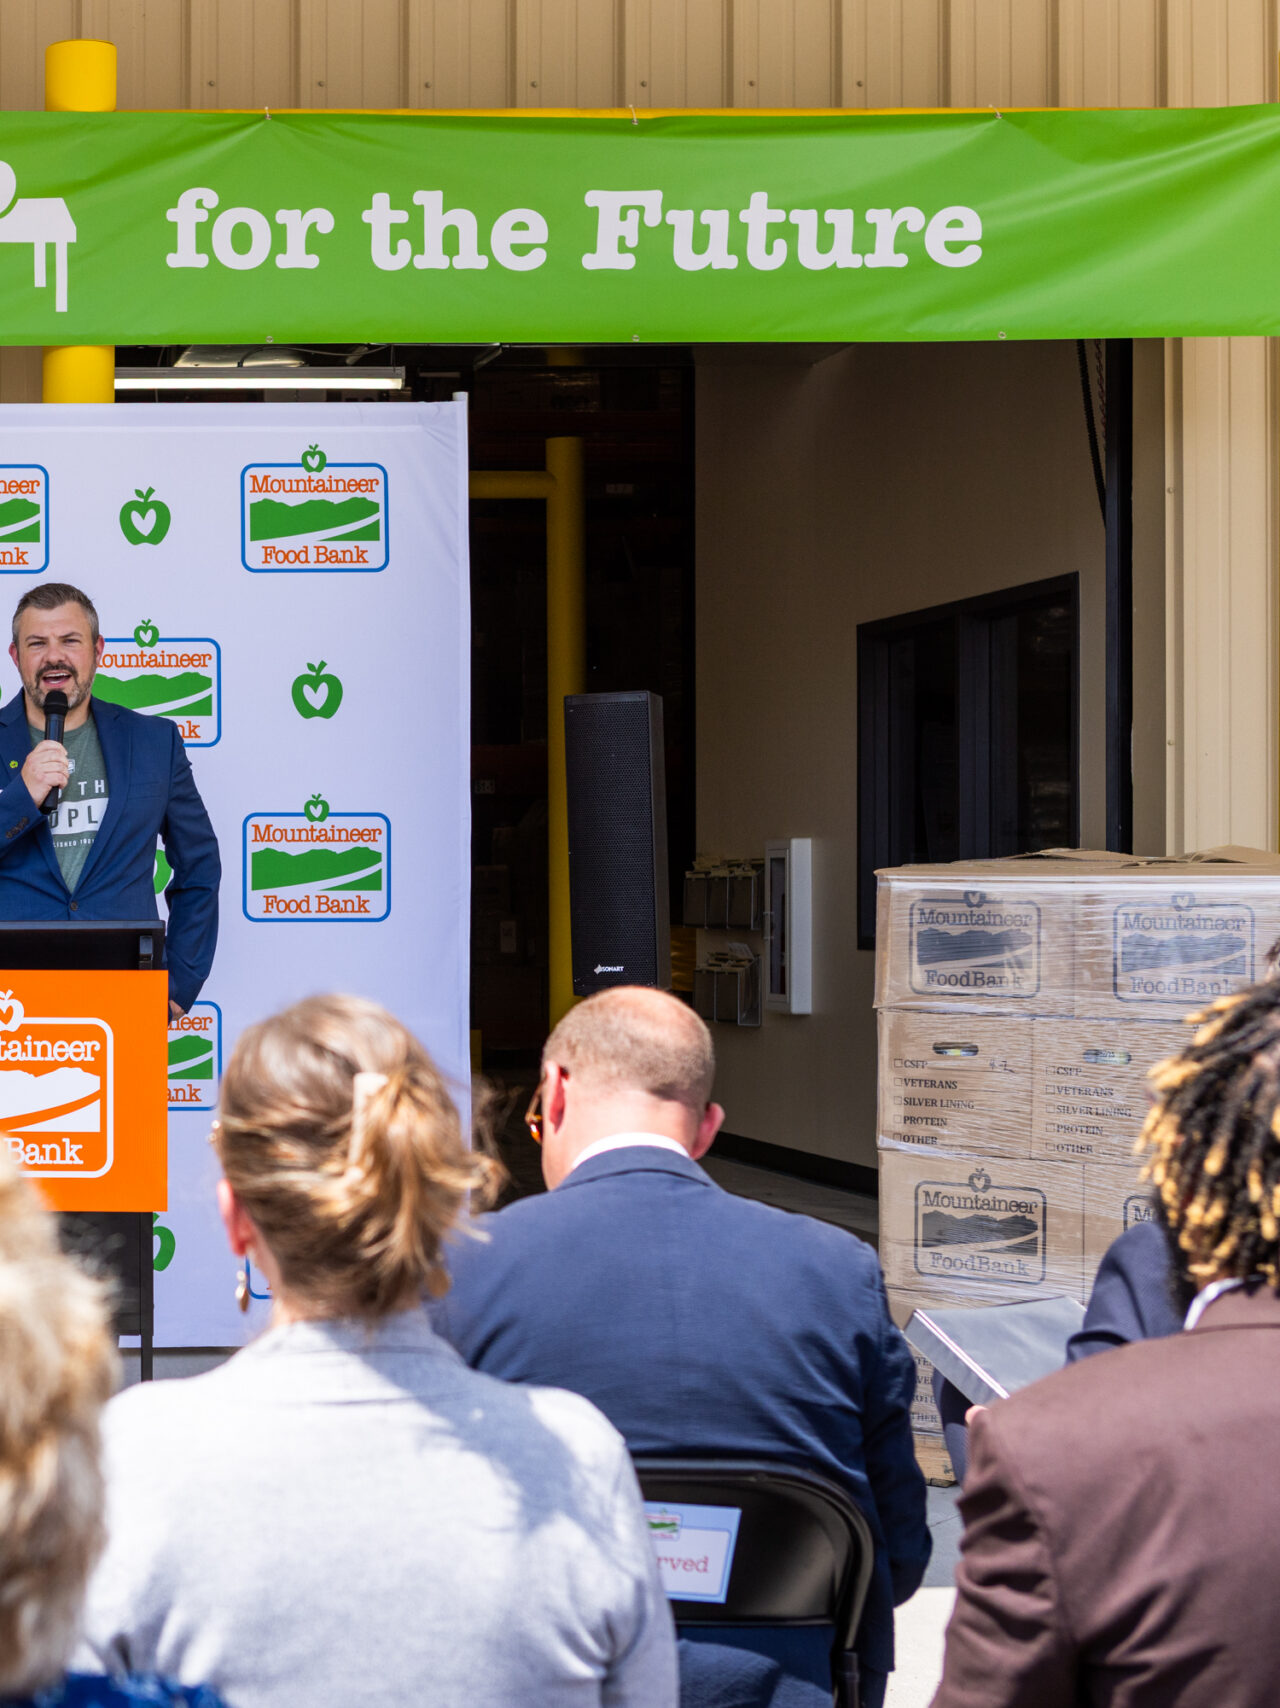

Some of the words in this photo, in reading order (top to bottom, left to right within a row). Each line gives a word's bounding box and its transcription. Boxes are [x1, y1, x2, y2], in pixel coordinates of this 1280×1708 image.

[165, 187, 335, 271] for
[361, 190, 549, 272] the
[581, 189, 983, 272] Future
[248, 474, 380, 494] Mountaineer
[261, 544, 311, 565] Food
[313, 544, 369, 565] Bank
[98, 649, 213, 669] ountaineer
[77, 779, 105, 796] TH
[250, 823, 383, 844] Mountaineer
[263, 894, 313, 915] Food
[315, 894, 371, 915] Bank
[917, 908, 1032, 927] Mountaineer
[1122, 912, 1246, 932] Mountaineer
[903, 1078, 958, 1089] VETERANS
[1056, 1085, 1114, 1096] VETERANS
[903, 1097, 938, 1107] SILVER
[940, 1099, 975, 1109] LINING
[1056, 1105, 1093, 1115] SILVER
[903, 1115, 948, 1126] PROTEIN
[1056, 1124, 1104, 1135] PROTEIN
[902, 1134, 938, 1145] OTHER
[1056, 1143, 1094, 1154] OTHER
[923, 1190, 1038, 1214] Mountaineer
[657, 1556, 710, 1574] rved
